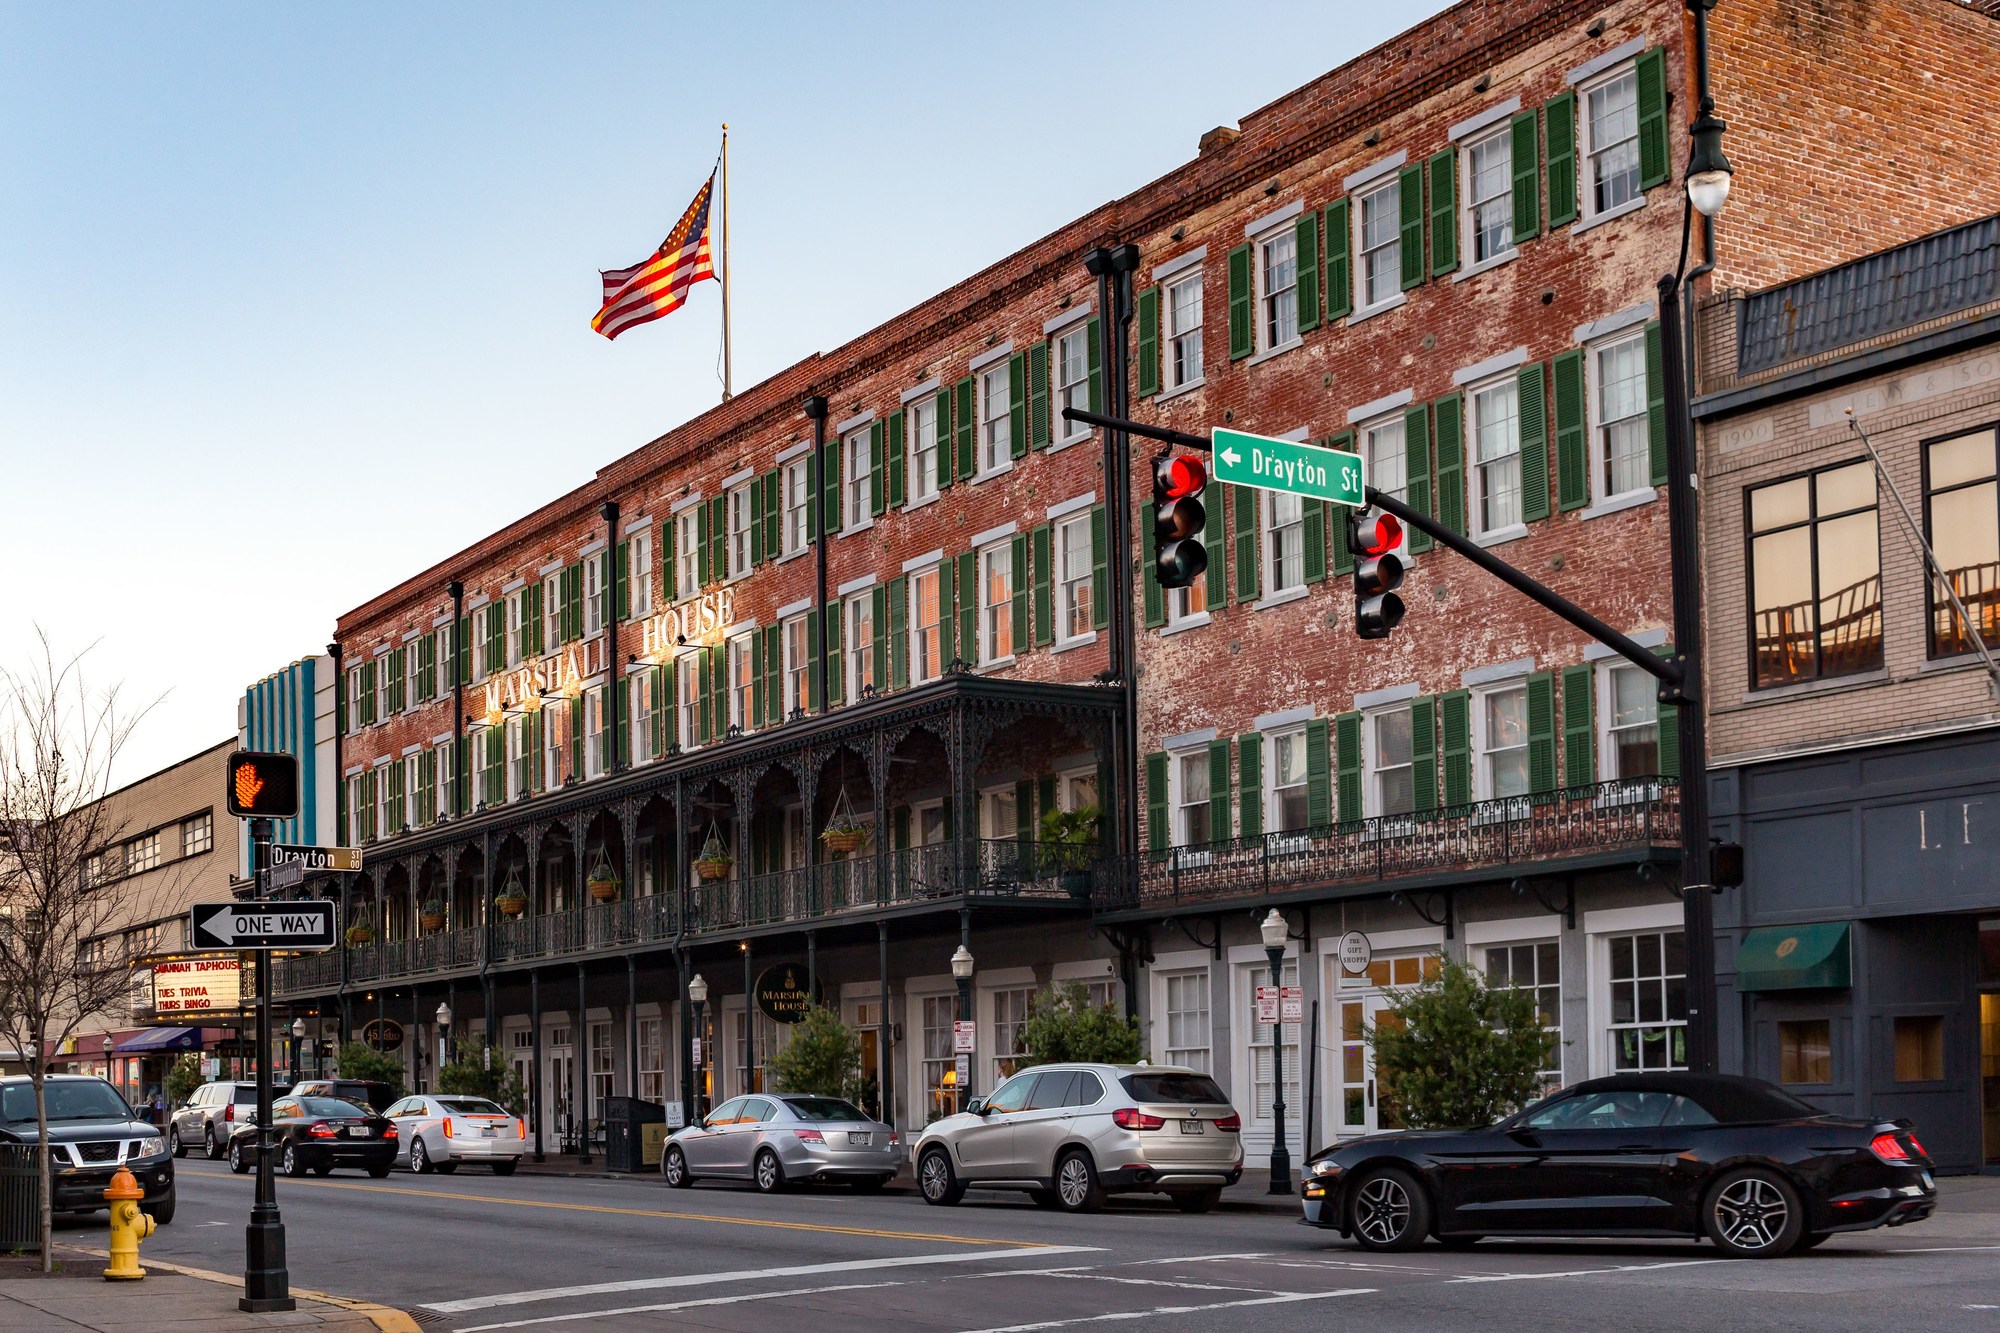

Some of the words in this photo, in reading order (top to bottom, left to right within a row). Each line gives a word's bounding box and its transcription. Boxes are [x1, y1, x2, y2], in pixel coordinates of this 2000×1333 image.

[1725, 423, 1768, 448] 1900
[1252, 448, 1327, 487] Drayton
[1341, 466, 1359, 493] St
[484, 636, 610, 714] MARSHALL
[641, 586, 736, 655] HOUSE
[275, 846, 335, 868] Drayton
[351, 850, 360, 860] ST
[235, 917, 273, 934] ONE
[280, 915, 319, 933] WAY
[154, 963, 191, 974] SAVANNAH
[157, 988, 175, 998] TUES
[180, 986, 208, 997] TRIVIA
[159, 1001, 181, 1010] THURS
[184, 999, 211, 1009] BINGO
[774, 1001, 809, 1011] HOUSE
